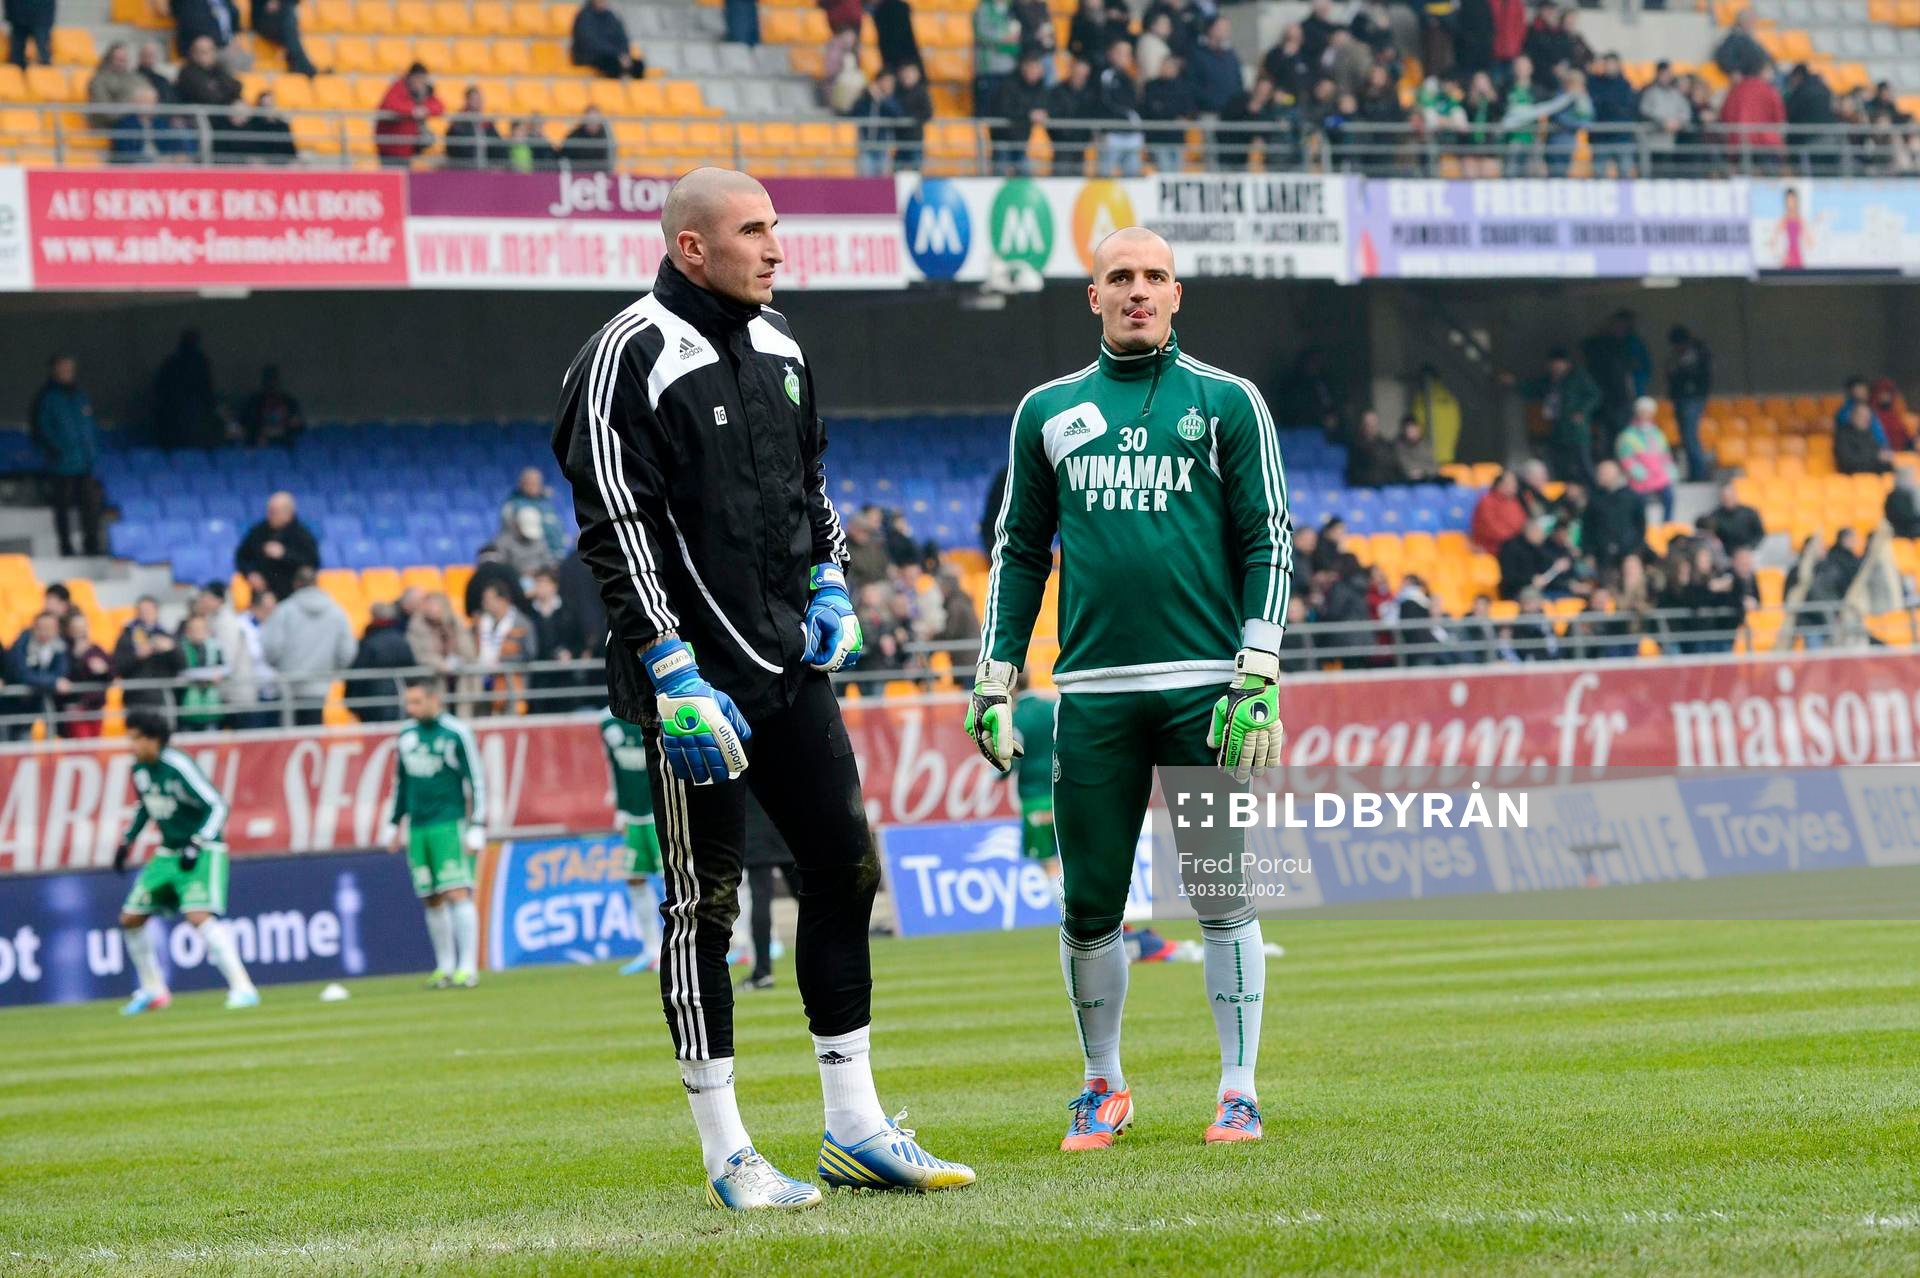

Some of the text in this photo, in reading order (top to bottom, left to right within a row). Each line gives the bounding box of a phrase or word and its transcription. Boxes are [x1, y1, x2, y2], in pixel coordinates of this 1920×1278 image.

[48, 189, 384, 221] AU SERVICE DES AUBOIS
[913, 205, 962, 255] M
[679, 345, 704, 361] adidas
[715, 408, 726, 423] 16
[1063, 427, 1091, 438] adidas
[1117, 426, 1148, 452] 30
[1065, 455, 1196, 492] WINAMAX
[1086, 488, 1168, 512] POKER
[1671, 665, 1920, 768] maison
[718, 725, 745, 771] uhlsport
[1696, 802, 1852, 870] Troyes
[1313, 830, 1478, 899] Troyes
[899, 854, 1058, 931] Troye
[514, 892, 642, 952] ESTA
[1215, 992, 1262, 1004] ASSE
